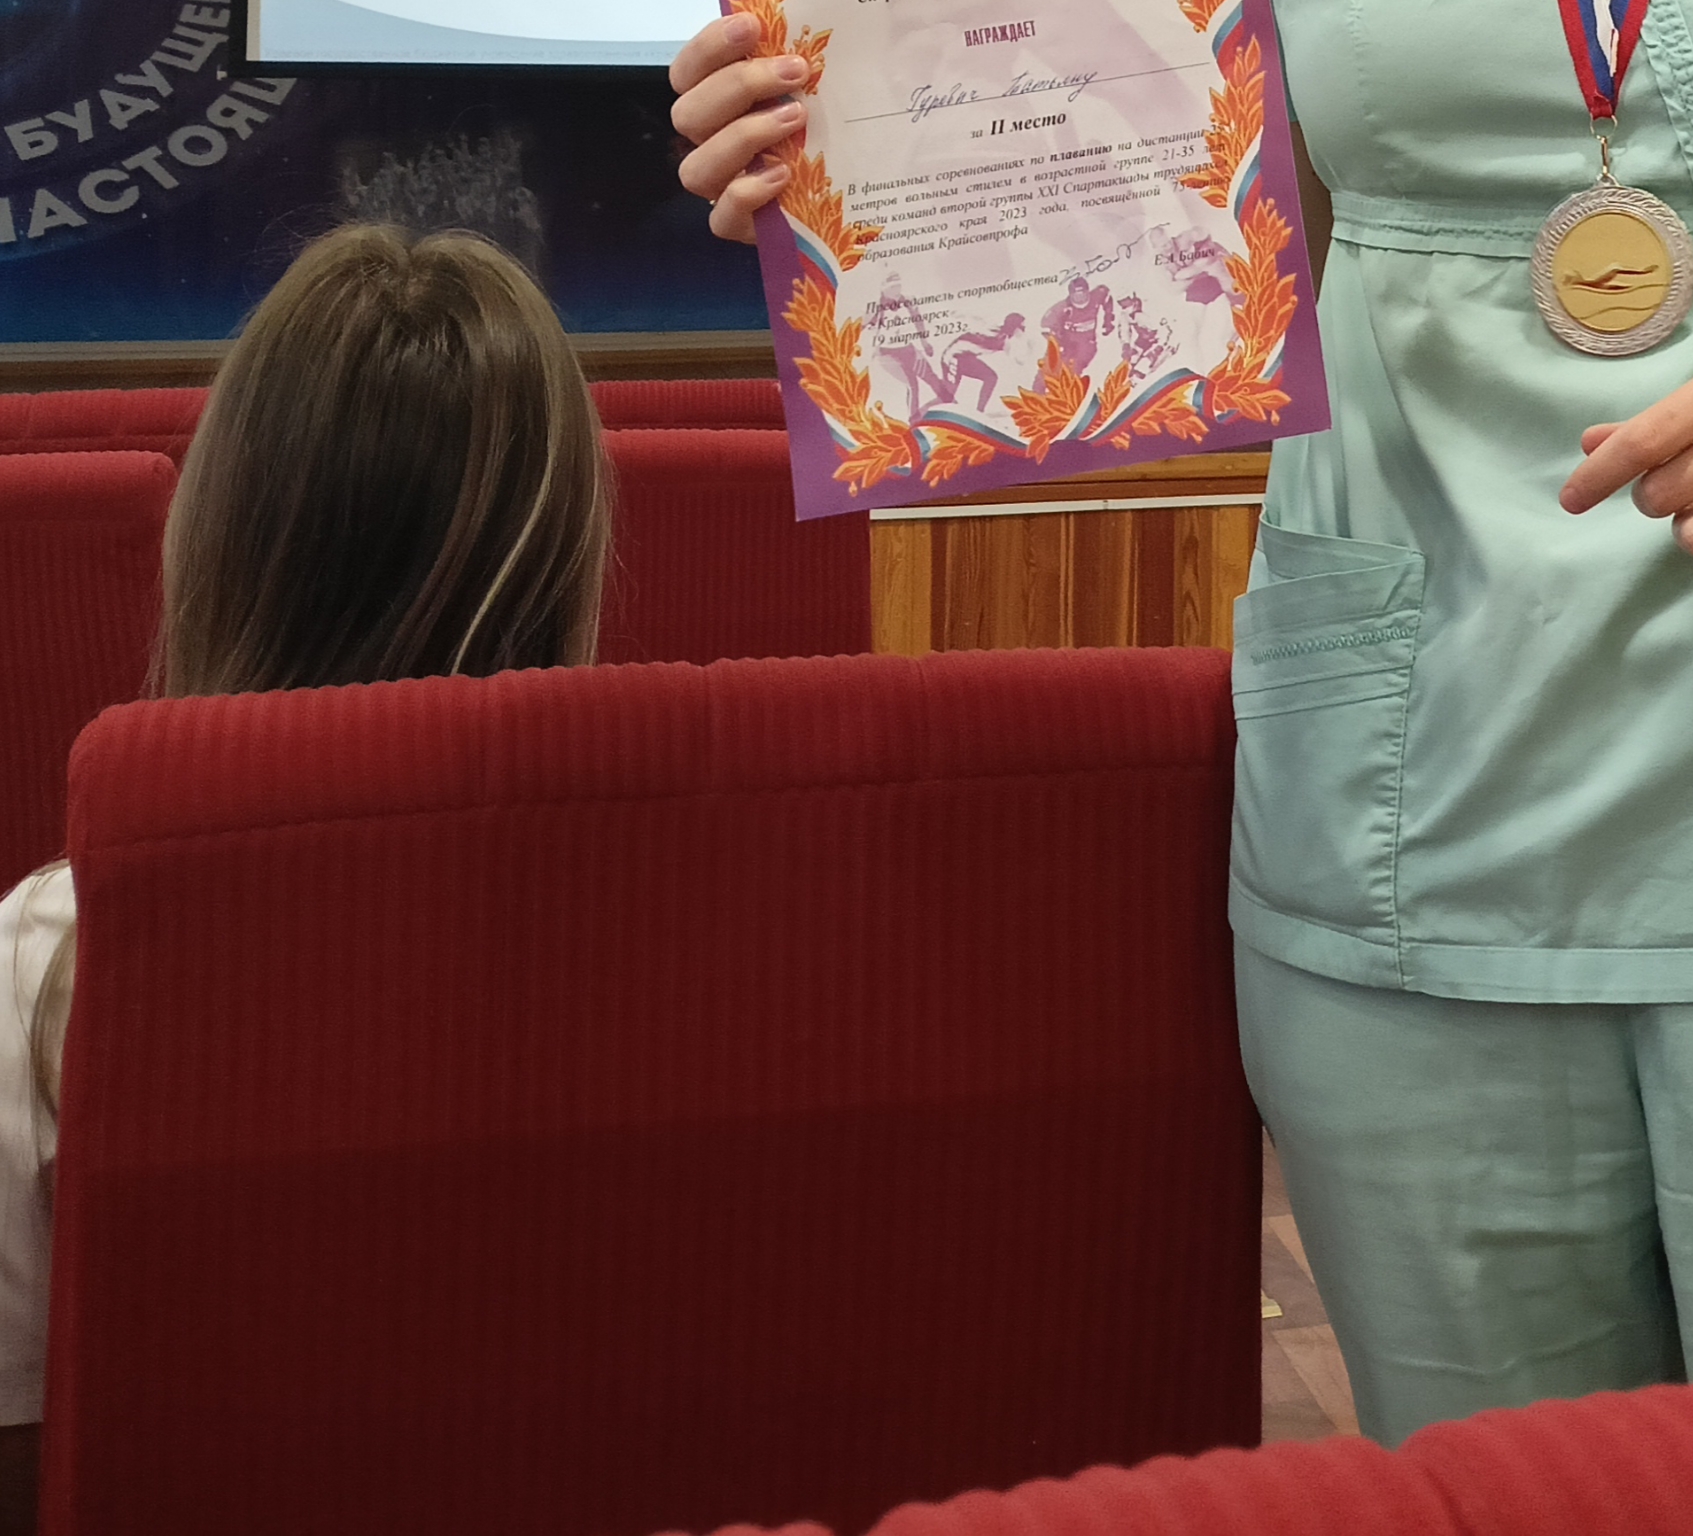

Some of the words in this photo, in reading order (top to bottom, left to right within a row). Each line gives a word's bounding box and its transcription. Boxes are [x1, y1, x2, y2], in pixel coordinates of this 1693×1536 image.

[963, 19, 1037, 48] НАГРАЖДАЕТ
[969, 129, 984, 140] за
[989, 119, 1006, 137] II
[1008, 112, 1067, 134] место
[846, 183, 857, 197] В
[860, 174, 931, 196] финальных
[935, 157, 1026, 182] соревнованиях
[1029, 156, 1045, 167] по
[1049, 144, 1113, 163] плаванию
[1117, 141, 1133, 152] на
[1136, 128, 1205, 148] дистанции
[849, 197, 898, 212] метров
[905, 187, 959, 203] вольным
[965, 178, 1013, 194] стилем
[1019, 174, 1028, 184] в
[1033, 159, 1107, 183] возрастной
[1113, 155, 1155, 172] группе
[1161, 144, 1195, 162] 21-35
[891, 204, 937, 223] команд
[940, 195, 987, 215] второй
[988, 190, 1034, 212] группы
[1062, 171, 1150, 196] Спартакиады
[958, 217, 988, 231] края
[999, 206, 1028, 222] 2023
[1080, 185, 1161, 209] посвящённой
[857, 242, 935, 263] образования
[937, 224, 1029, 251] Крайсовпрофа
[865, 292, 955, 316] Председатель
[956, 272, 1059, 301] спортобщества
[871, 334, 886, 348] 19
[887, 330, 930, 346] марта
